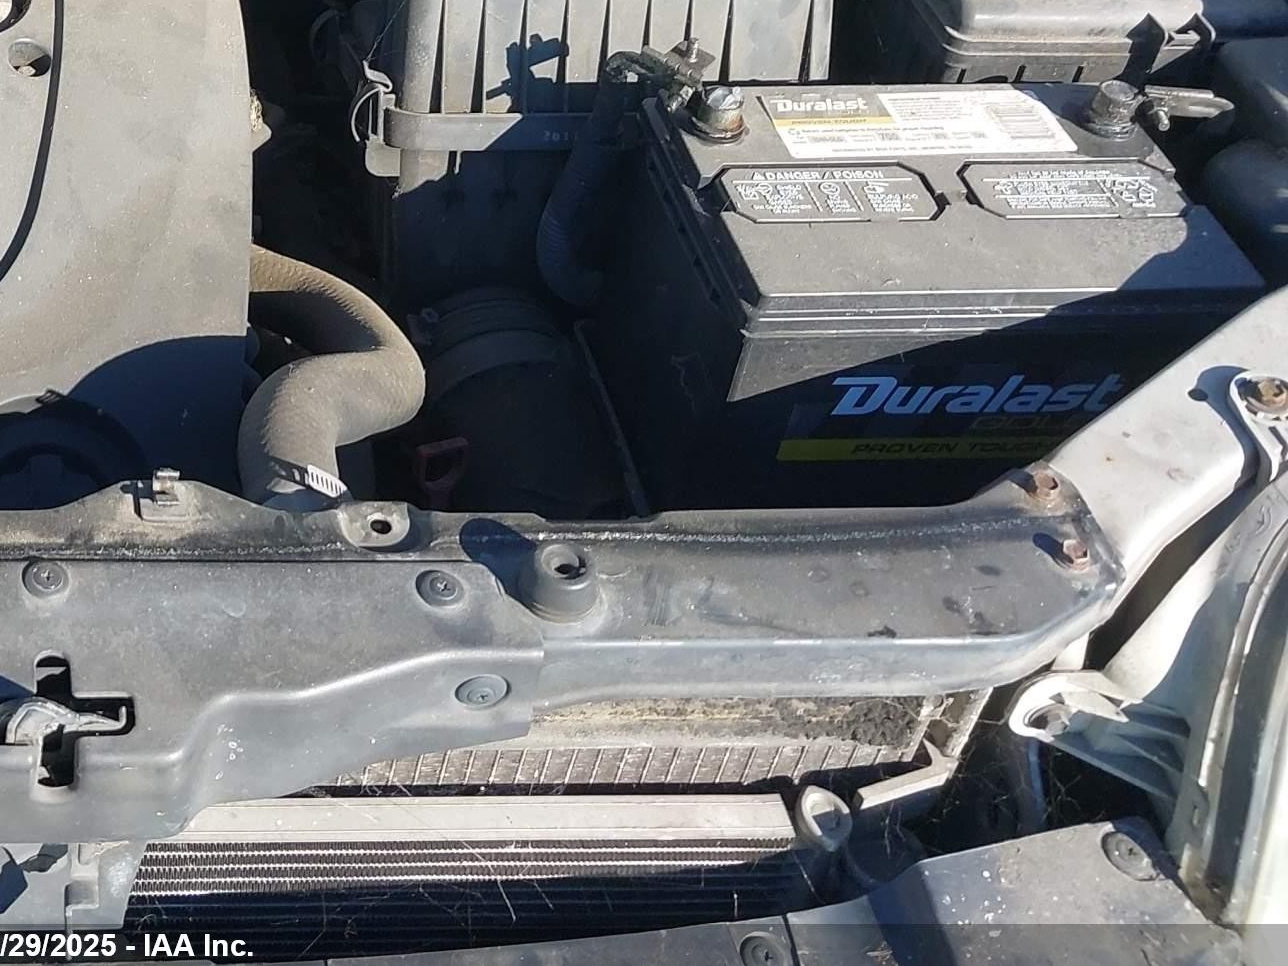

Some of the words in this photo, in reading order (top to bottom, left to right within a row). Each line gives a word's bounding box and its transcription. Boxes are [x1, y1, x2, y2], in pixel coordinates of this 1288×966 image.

[770, 98, 868, 113] Duralast
[765, 171, 821, 181] DANGER
[832, 170, 885, 180] POISON
[831, 374, 1125, 416] Duralast
[850, 441, 958, 455] PROVEN
